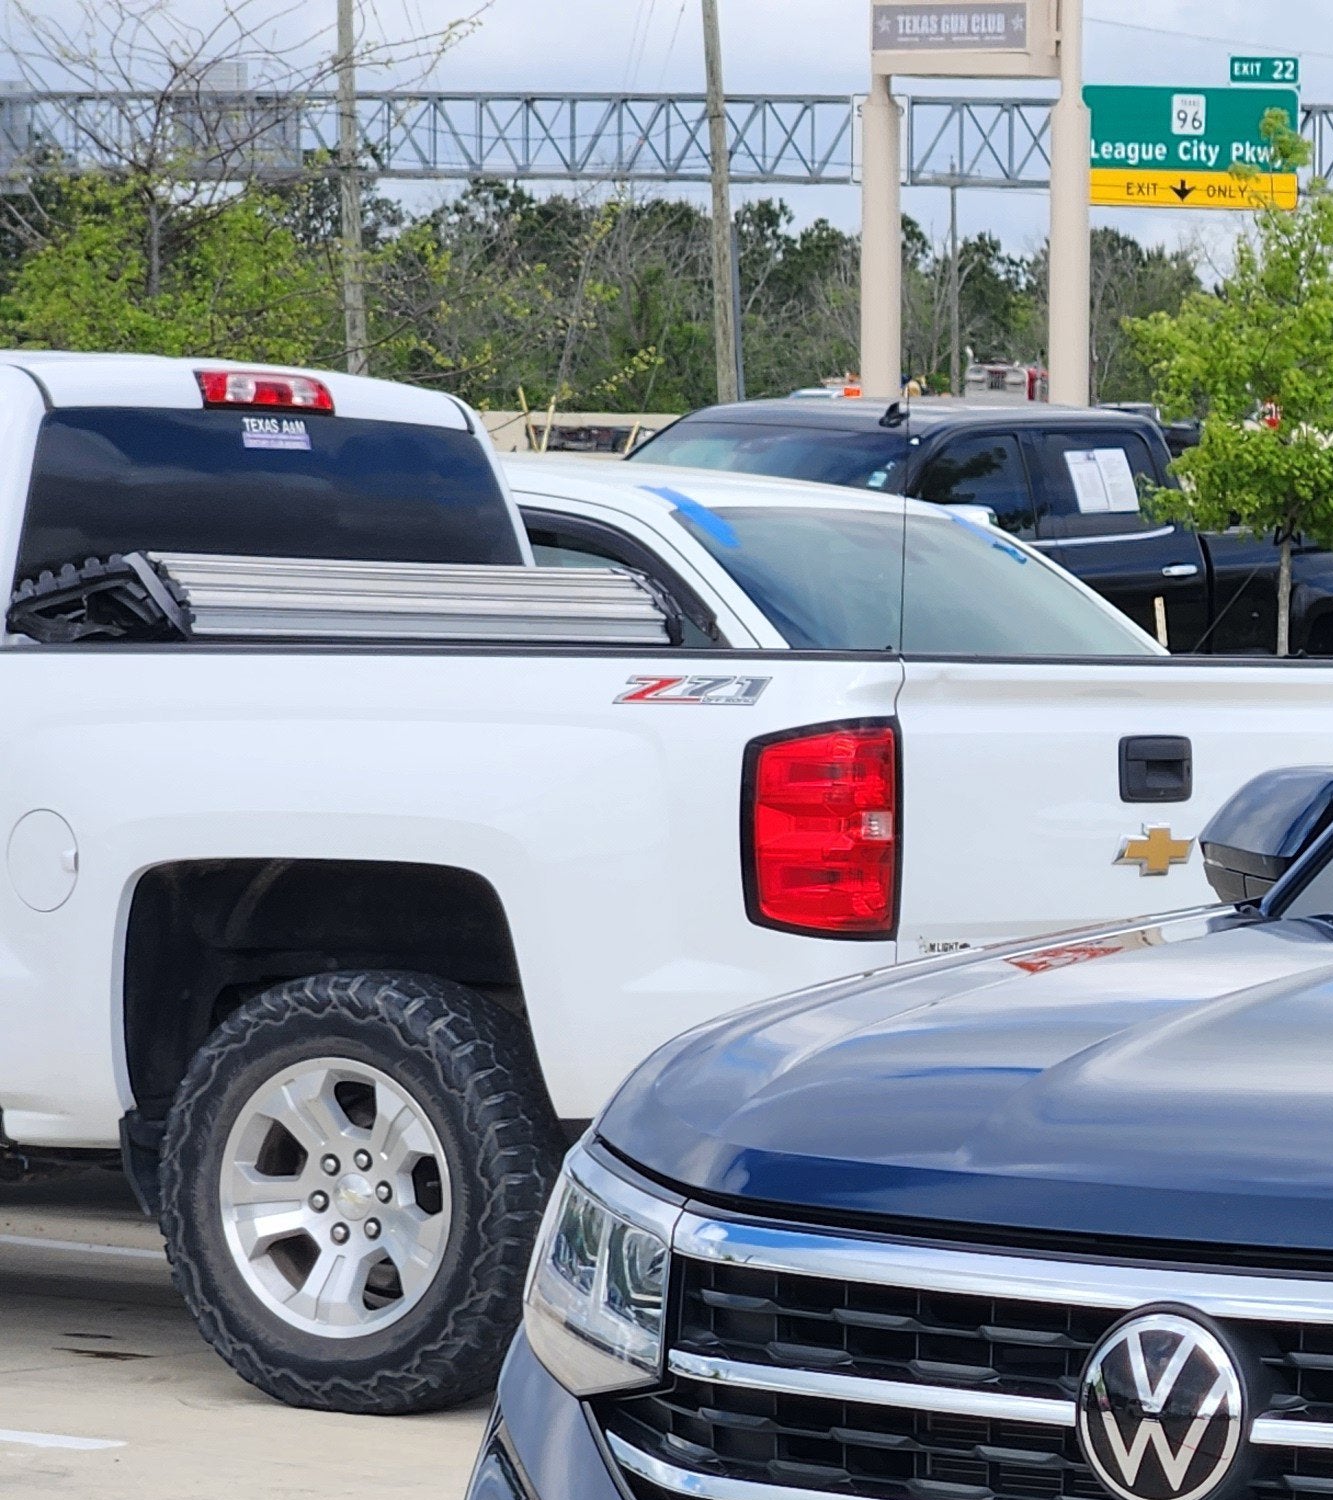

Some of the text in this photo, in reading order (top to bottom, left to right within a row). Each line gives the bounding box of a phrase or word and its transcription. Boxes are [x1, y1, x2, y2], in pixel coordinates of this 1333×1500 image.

[897, 12, 1006, 34] TEXAS GUN CLUB
[1233, 59, 1295, 80] EXIT 22
[1177, 109, 1202, 130] 96
[1090, 138, 1167, 166] League
[1178, 139, 1219, 167] City
[1126, 182, 1248, 198] EXIT ONLY
[242, 416, 306, 435] TEXAS A&M
[612, 675, 773, 706] Z71
[1088, 1320, 1236, 1500] VW
